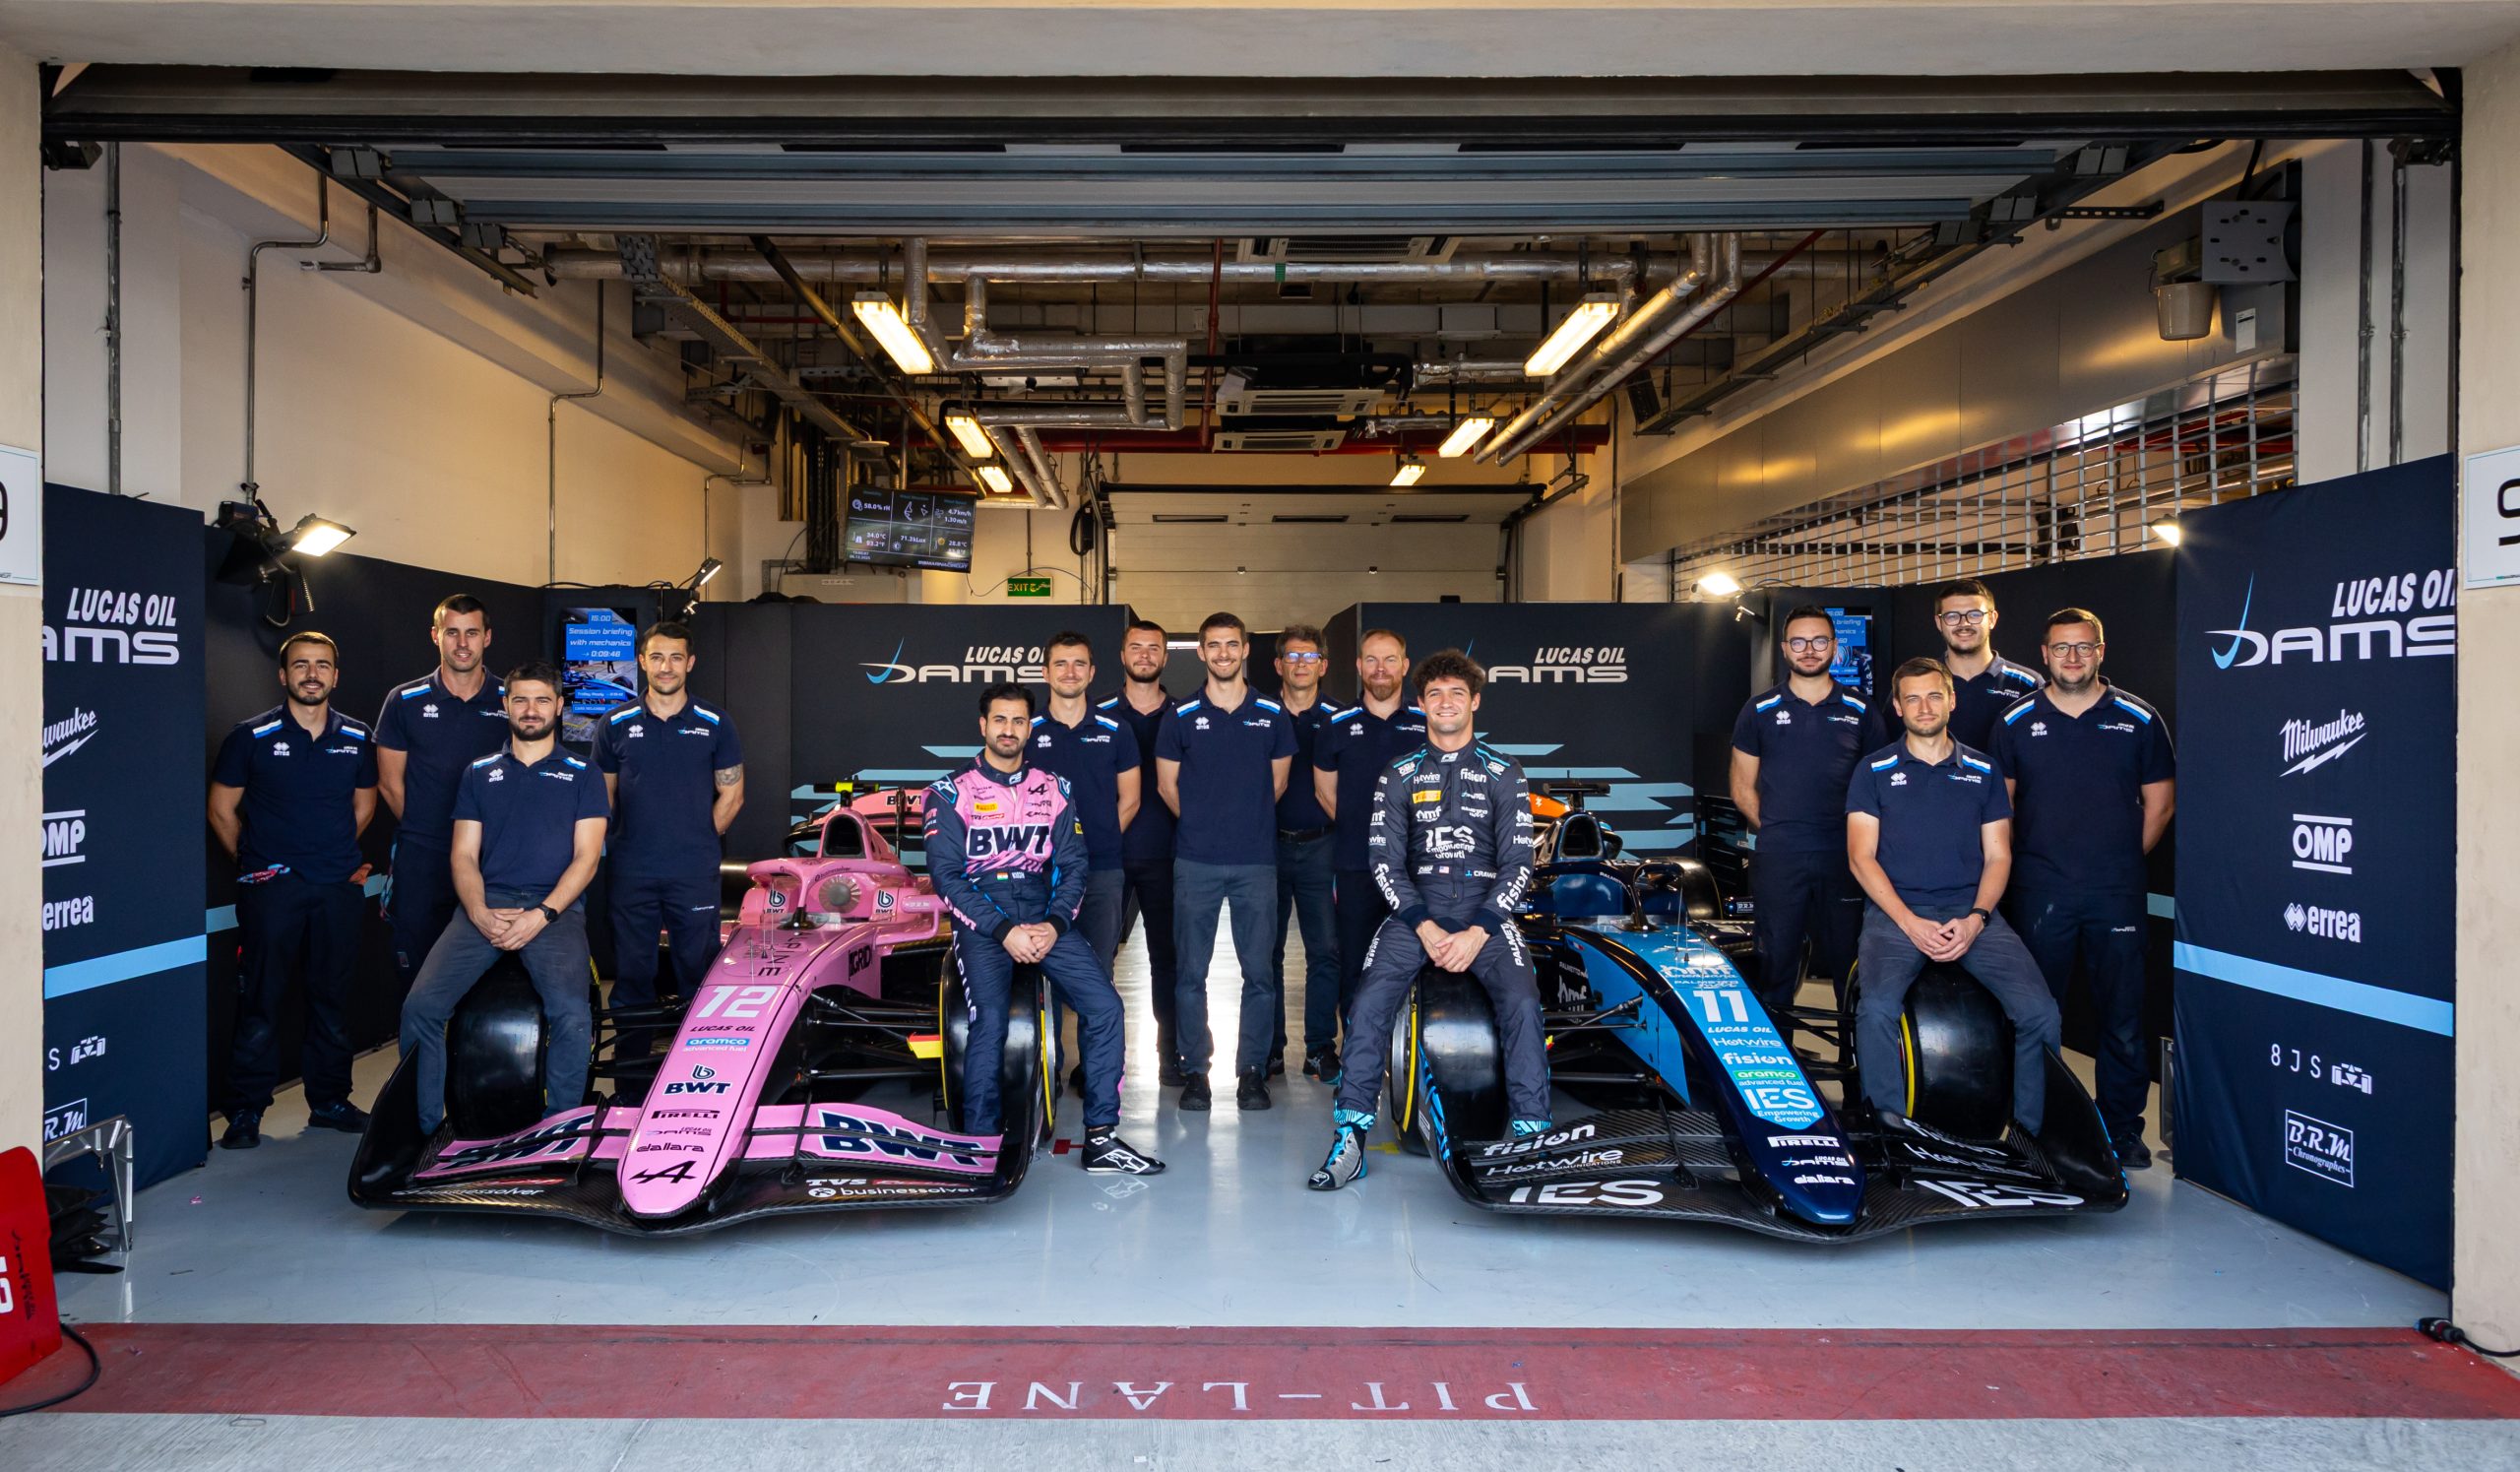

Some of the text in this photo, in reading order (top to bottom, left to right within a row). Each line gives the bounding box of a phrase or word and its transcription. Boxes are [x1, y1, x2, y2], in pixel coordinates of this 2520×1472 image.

[1008, 583, 1029, 592] EXIT
[2332, 572, 2417, 617] LUCAS
[66, 587, 177, 626] LUCAS OIL
[602, 627, 633, 637] briefing
[43, 625, 180, 666] MS
[965, 646, 1045, 664] LUCAS OI
[1535, 647, 1626, 664] LUCAS OIL
[1487, 666, 1628, 683] AMS
[42, 707, 96, 748] waukee
[2279, 708, 2365, 763] Milwaukee
[42, 819, 86, 857] MP
[967, 824, 1050, 860] BWT
[2293, 824, 2353, 863] OMP
[695, 986, 777, 1018] 12
[1693, 990, 1749, 1023] 11
[1713, 1037, 1782, 1047] Hotwire
[1722, 1052, 1794, 1065] fision
[662, 1082, 732, 1096] BWT
[1744, 1088, 1815, 1110] IES
[651, 1109, 721, 1119] PIRELLI
[1757, 1110, 1820, 1119] Empowering
[636, 1143, 705, 1152] dallara
[818, 1109, 985, 1168] BWT
[1483, 1123, 1596, 1156] fision
[1767, 1135, 1840, 1147] PIRELLI
[1486, 1149, 1624, 1176] Hotwire
[1544, 1159, 1622, 1172] COMMUNICATIONS
[841, 1185, 978, 1196] businessolver
[1794, 1175, 1856, 1184] dallara
[1509, 1180, 1664, 1206] IES
[1914, 1180, 2085, 1207] IES
